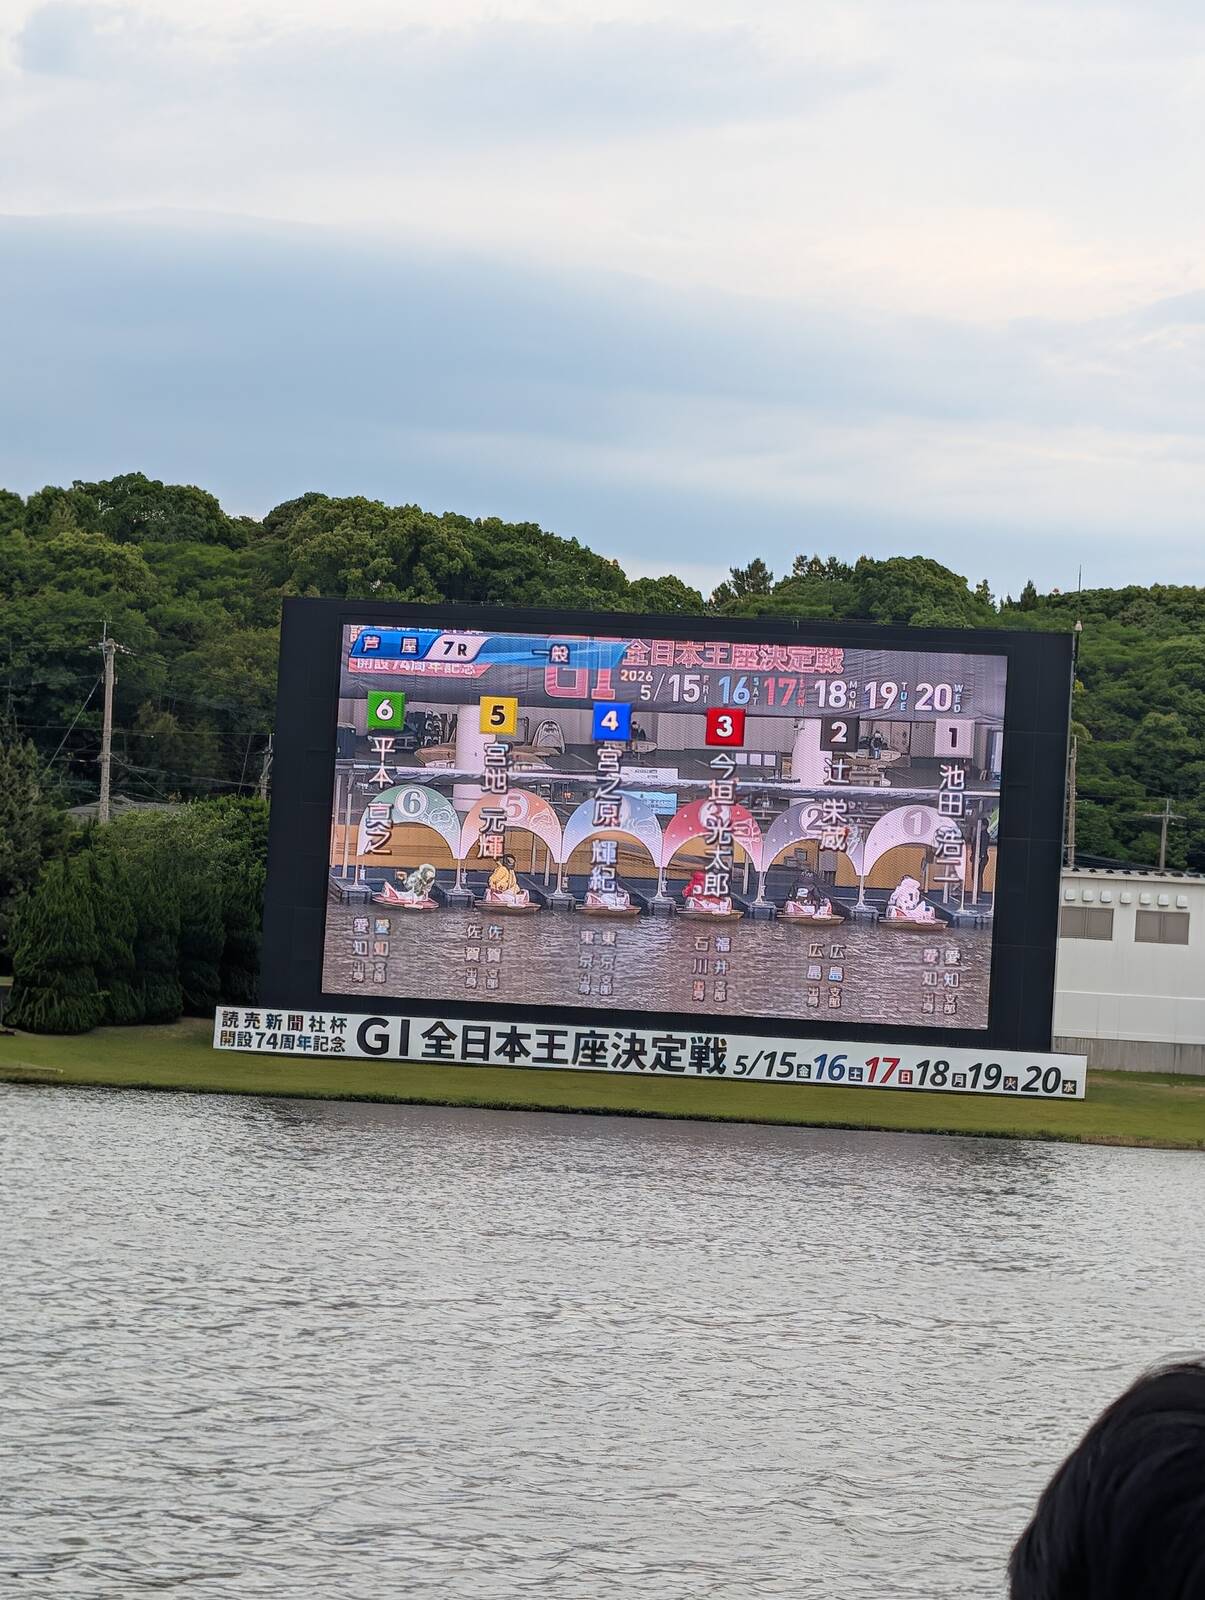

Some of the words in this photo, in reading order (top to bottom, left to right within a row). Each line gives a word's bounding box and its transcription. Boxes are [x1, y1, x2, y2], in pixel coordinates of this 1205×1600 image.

[363, 636, 418, 654] 芦屋
[532, 645, 569, 663] 一般
[622, 638, 845, 675] 全日本王座決定戦
[620, 669, 654, 682] 2026
[718, 676, 750, 705] 16
[763, 677, 797, 706] 17
[814, 679, 848, 708] 18
[864, 681, 898, 710] 19
[914, 683, 953, 712] 20
[376, 699, 394, 721] 6
[490, 705, 506, 726] 5
[600, 711, 619, 731] 4
[715, 715, 734, 738] 3
[830, 722, 848, 744] 2
[948, 727, 958, 748] 1
[222, 1010, 348, 1034] 読売新聞社杯
[219, 1030, 346, 1053] 開設74周年記念
[1021, 1066, 1061, 1093] 20
